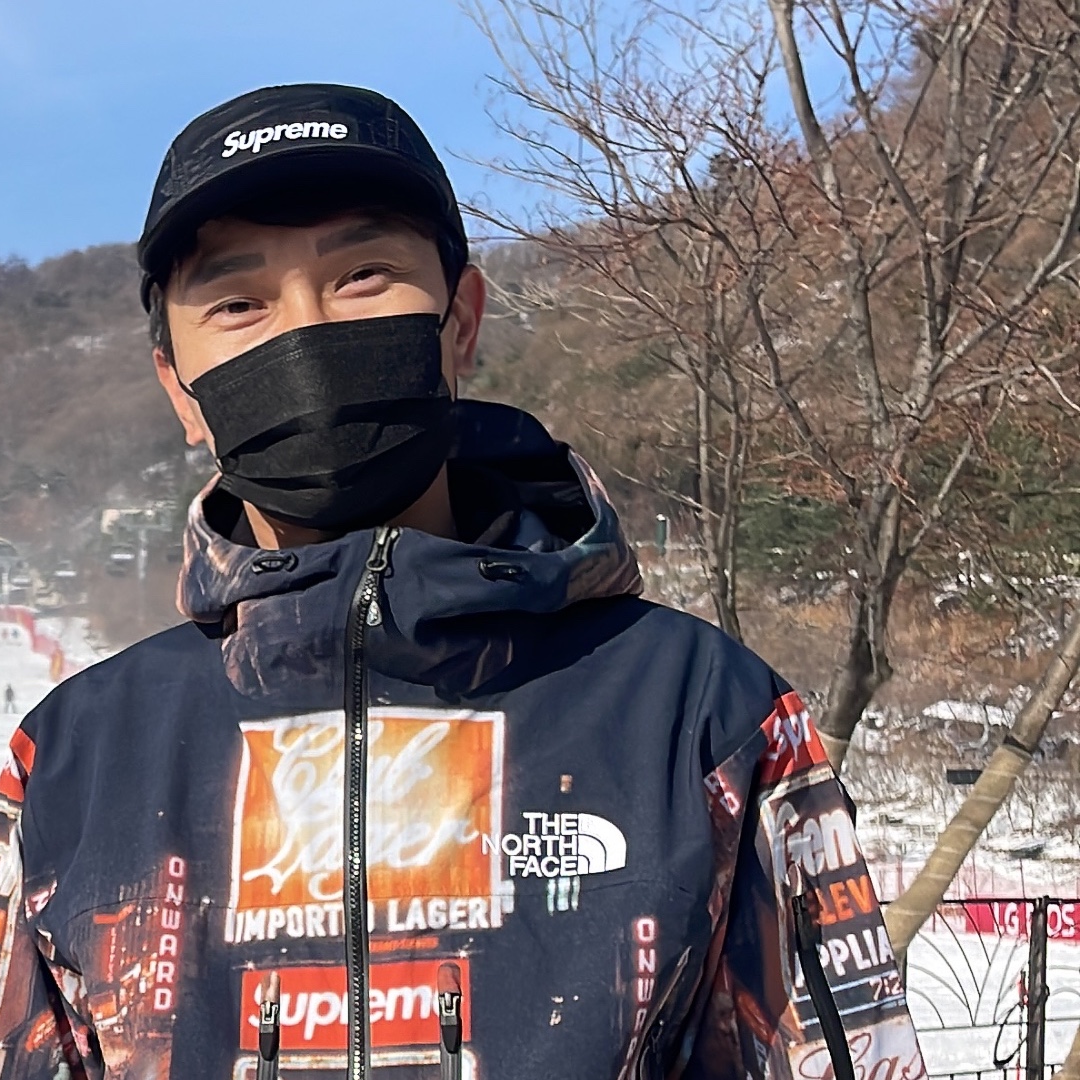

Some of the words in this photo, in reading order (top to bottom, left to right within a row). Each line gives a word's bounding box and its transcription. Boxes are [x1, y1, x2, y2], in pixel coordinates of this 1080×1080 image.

[222, 121, 348, 158] Supreme
[522, 812, 579, 836] THE
[481, 833, 578, 857] NORTH
[509, 855, 578, 878] FACE
[153, 856, 185, 1011] ONWARD
[235, 899, 376, 943] IMPORT
[387, 896, 492, 933] LAGER
